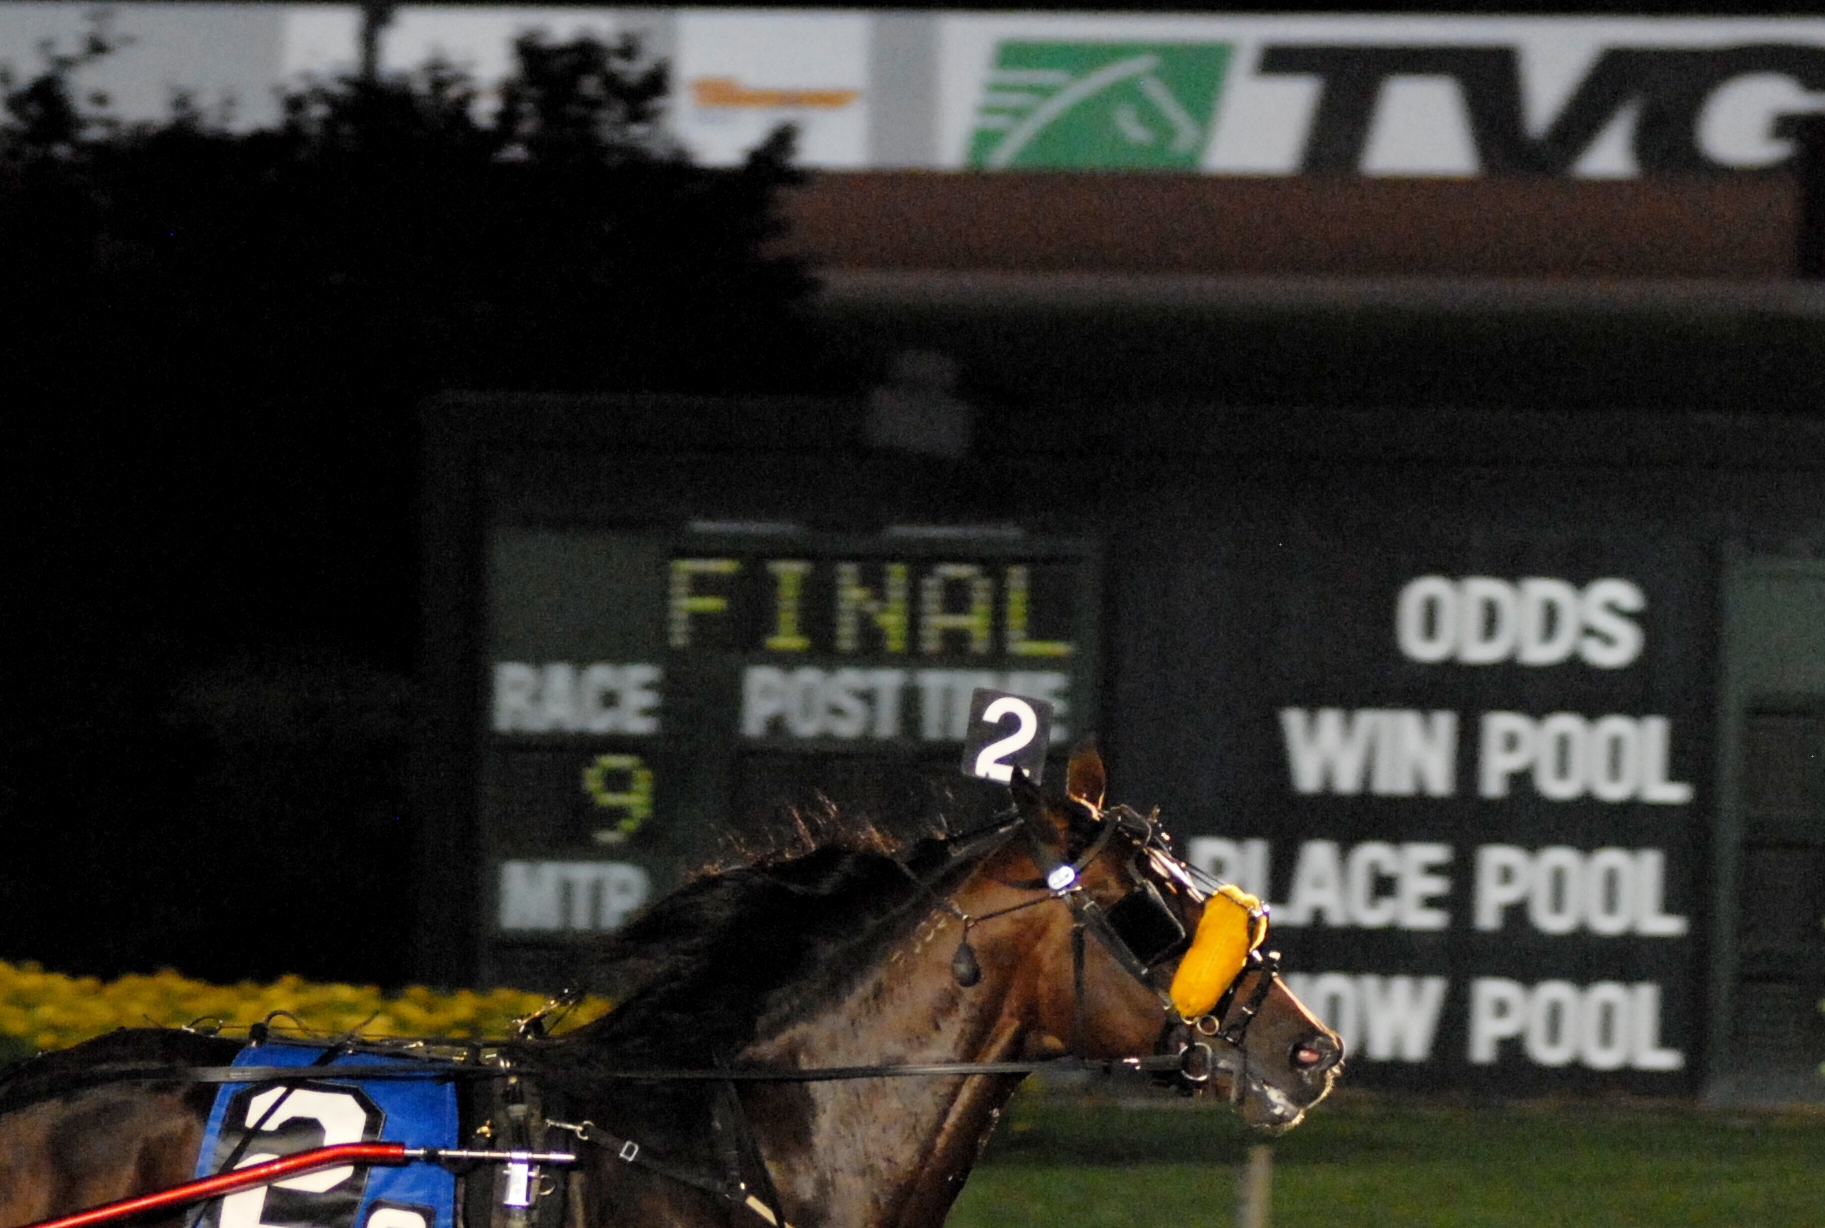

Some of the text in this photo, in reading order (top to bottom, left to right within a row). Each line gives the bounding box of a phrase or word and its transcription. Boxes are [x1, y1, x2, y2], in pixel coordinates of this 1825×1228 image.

[1255, 44, 1825, 178] TVG
[669, 557, 1075, 657] FINAL
[1396, 575, 1646, 668] ODDS
[491, 661, 663, 734] RACE
[741, 664, 906, 738] POST
[974, 697, 1037, 782] 2
[582, 754, 653, 843] 9
[1279, 706, 1693, 804] WIN POOL
[499, 861, 651, 929] MTP
[1475, 842, 1688, 936] POOL
[1468, 976, 1685, 1070] POOL
